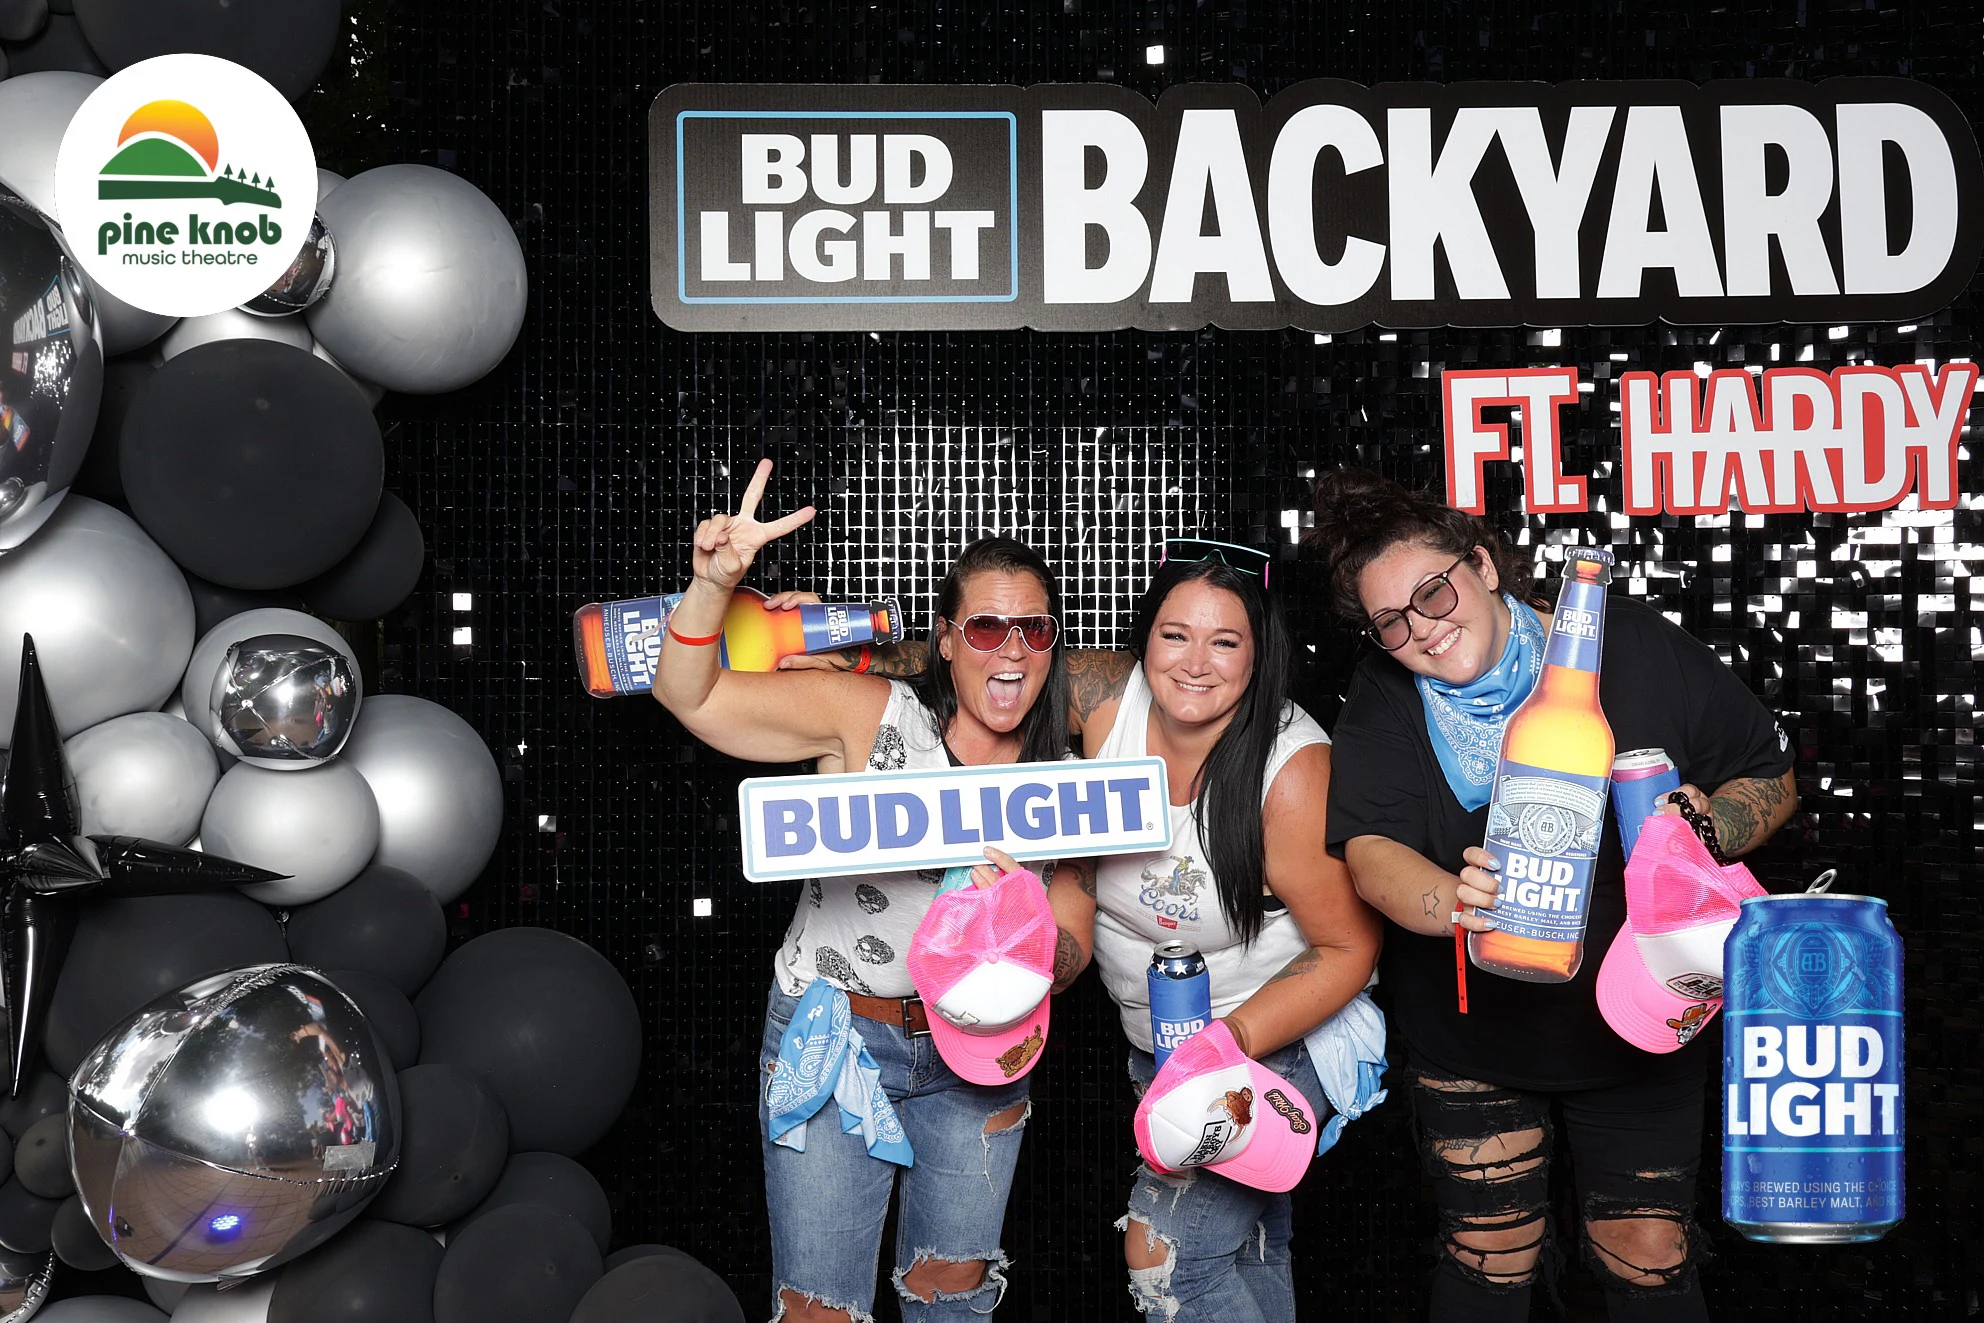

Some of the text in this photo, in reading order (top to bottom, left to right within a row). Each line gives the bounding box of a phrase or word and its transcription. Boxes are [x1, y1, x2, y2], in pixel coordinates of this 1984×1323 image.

[741, 133, 954, 205] BUD
[1041, 102, 1959, 306] BACKYARD
[700, 209, 995, 283] LIGHT
[1449, 370, 1971, 509] FT. HARDY
[827, 606, 842, 643] LIGHT
[837, 610, 849, 637] BUD
[1555, 619, 1597, 637] LIGHT
[1562, 609, 1593, 625] BUD
[623, 610, 652, 686] LIGHT
[641, 617, 662, 676] BUD
[763, 777, 1151, 858] BUD LIGHT
[1505, 852, 1575, 886] BUD
[1138, 885, 1200, 921] Coors
[1501, 904, 1526, 914] BREWED
[1513, 913, 1539, 922] BARLEY
[1495, 921, 1566, 941] EUSER-BUSCH,
[1156, 1033, 1194, 1049] LIG
[1160, 1019, 1204, 1036] BUD
